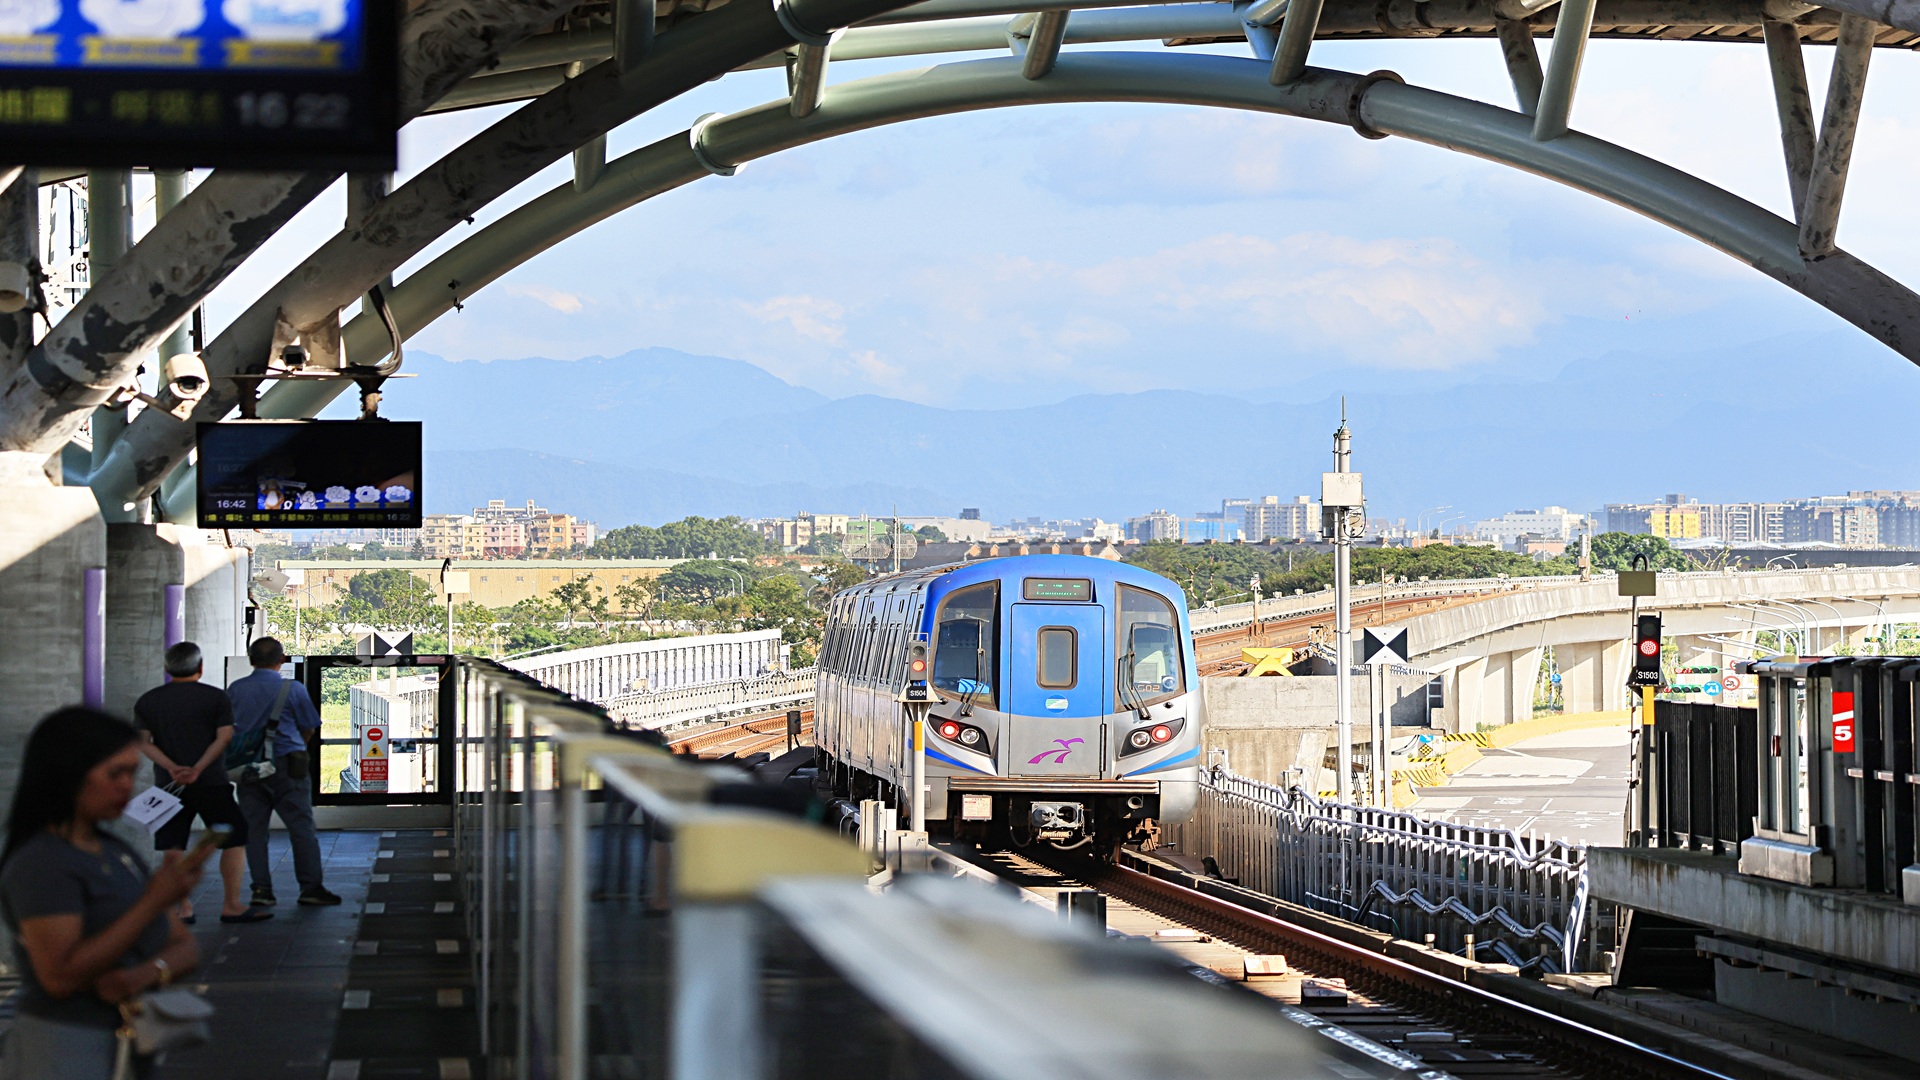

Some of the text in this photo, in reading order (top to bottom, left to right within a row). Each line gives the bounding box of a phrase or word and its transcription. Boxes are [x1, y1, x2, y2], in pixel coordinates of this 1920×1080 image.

[216, 500, 246, 508] 16:42
[1637, 671, 1658, 679] S1503
[1834, 725, 1852, 741] 5
